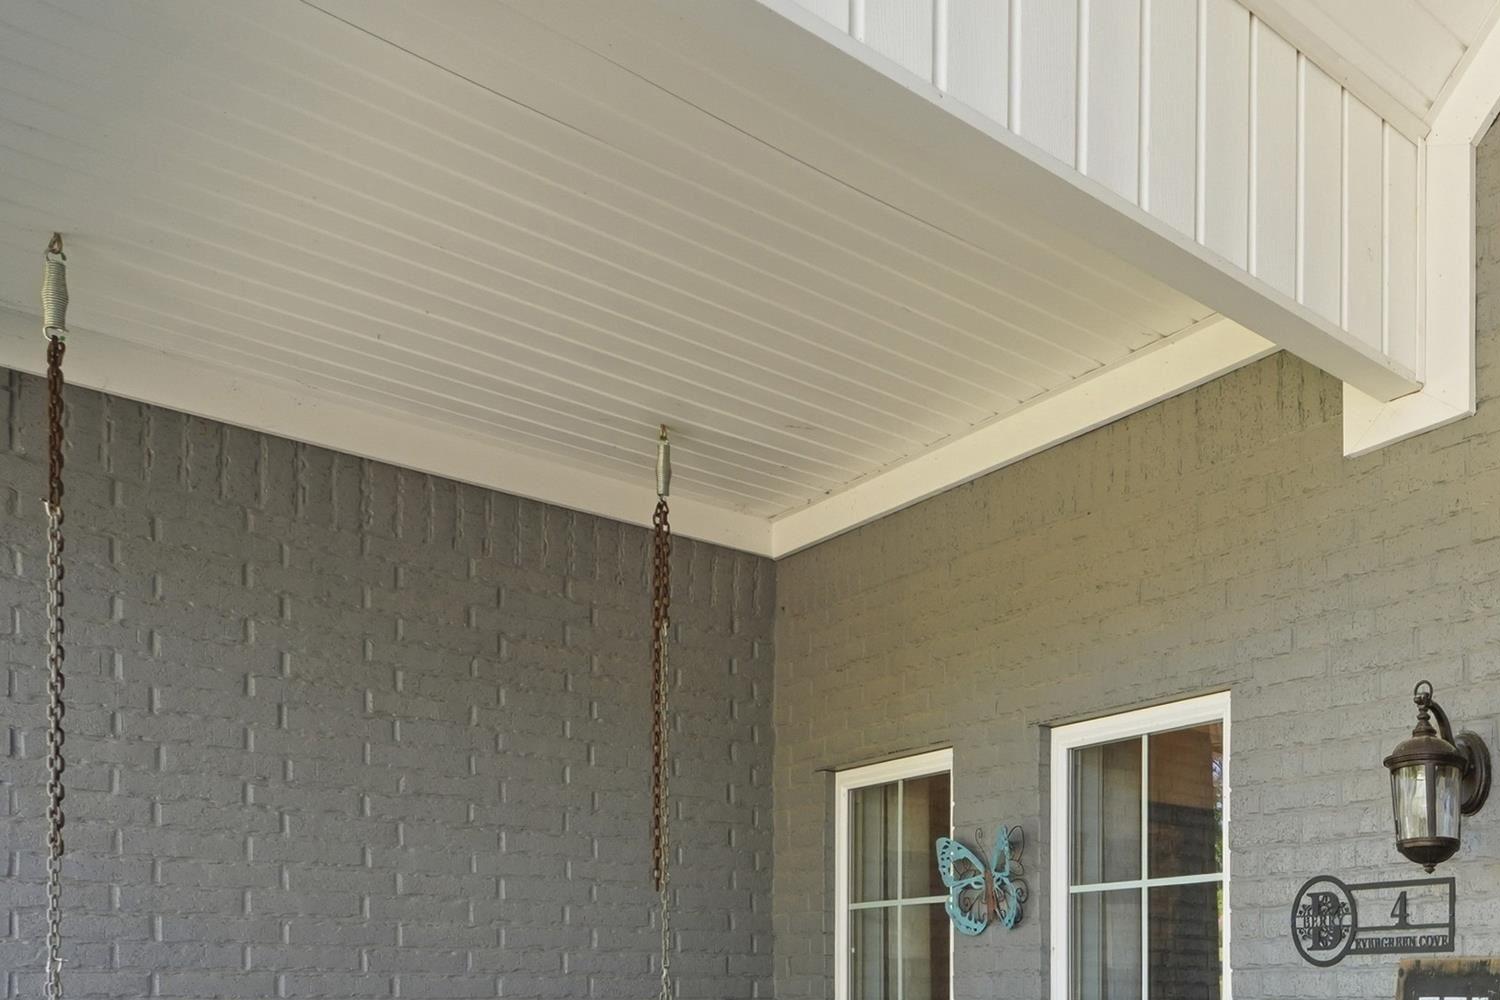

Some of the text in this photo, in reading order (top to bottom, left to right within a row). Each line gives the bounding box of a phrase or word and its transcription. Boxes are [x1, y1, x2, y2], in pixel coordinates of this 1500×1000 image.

[1390, 891, 1410, 928] 4
[1355, 934, 1448, 949] EVERGREEN COVE
